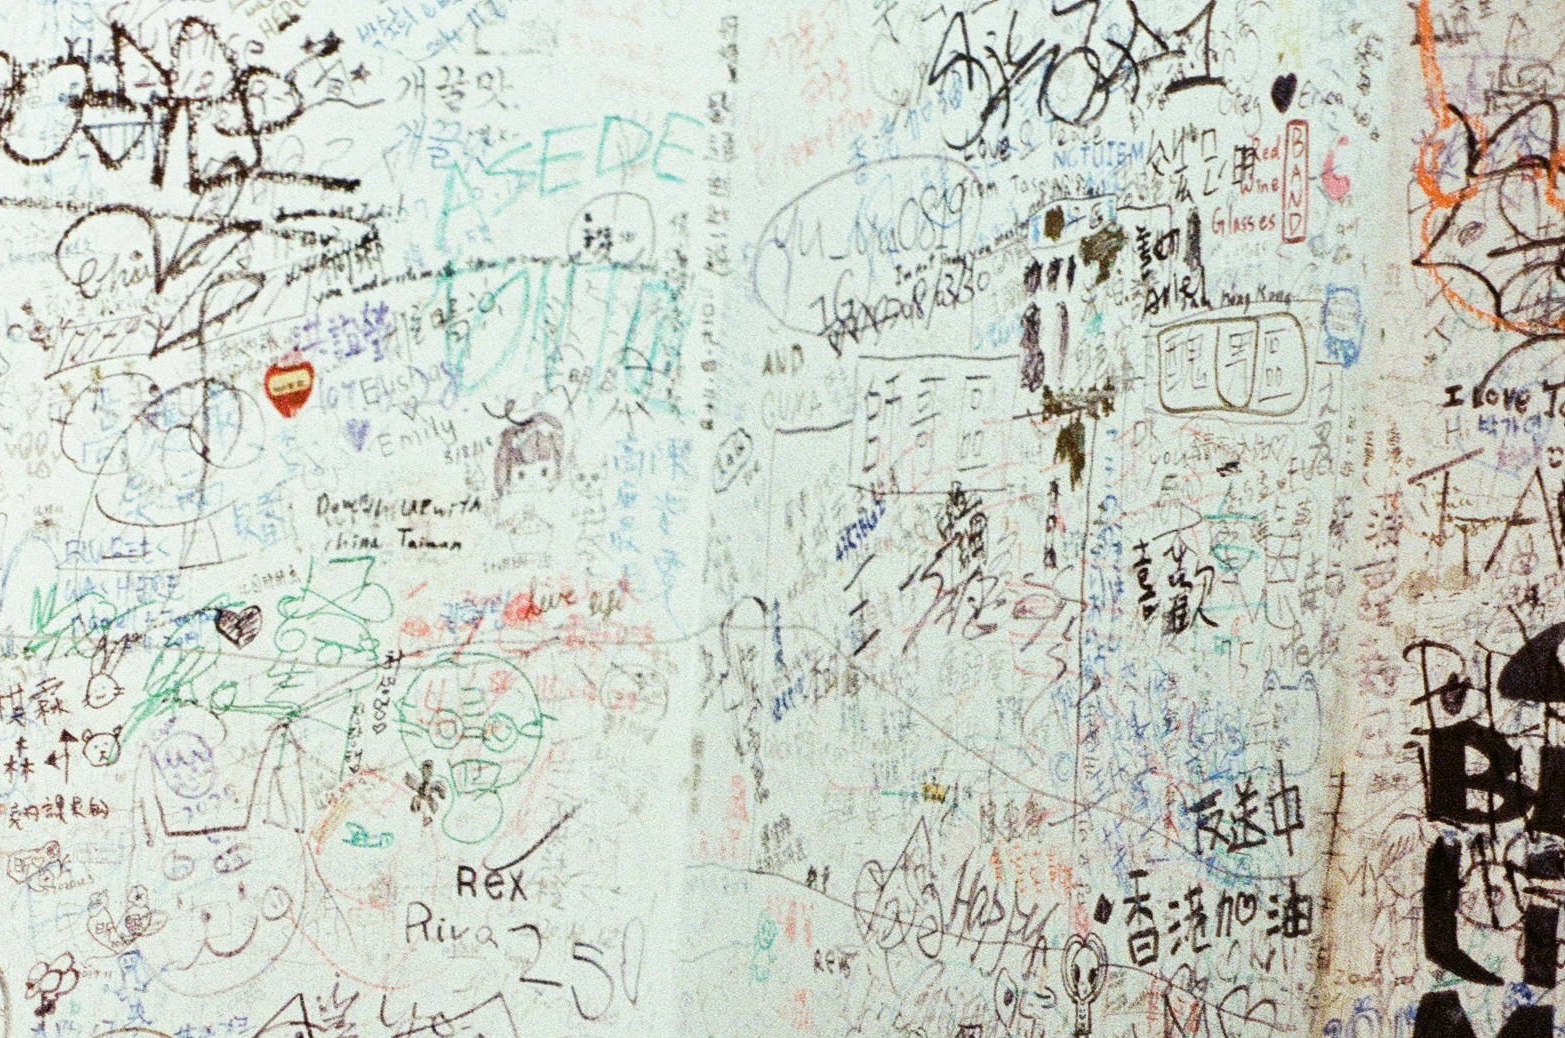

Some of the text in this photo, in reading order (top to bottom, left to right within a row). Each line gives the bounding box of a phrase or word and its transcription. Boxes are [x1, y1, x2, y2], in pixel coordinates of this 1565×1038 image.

[1133, 538, 1217, 636] 喜歡
[1186, 758, 1305, 857] 反送中
